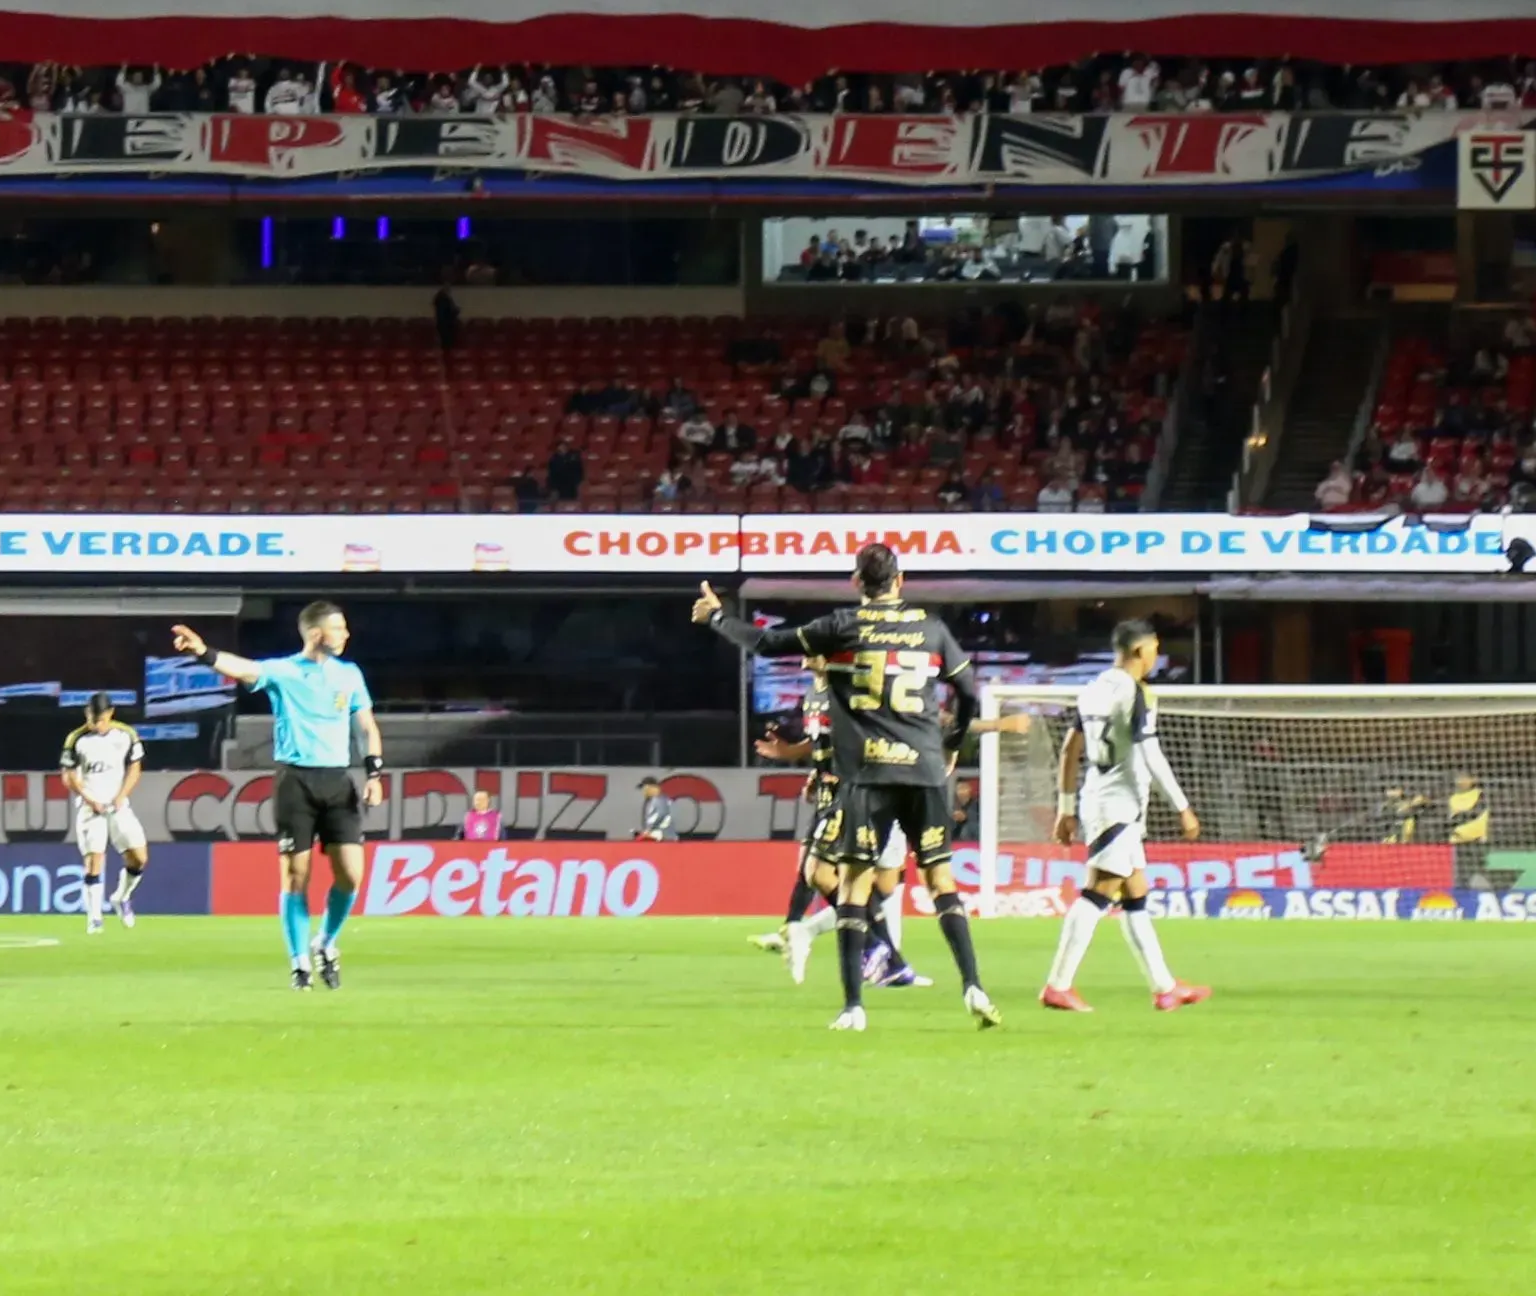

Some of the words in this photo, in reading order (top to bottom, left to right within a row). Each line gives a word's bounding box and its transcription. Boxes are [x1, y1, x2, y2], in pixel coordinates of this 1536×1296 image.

[43, 530, 296, 556] VERDADE.
[564, 530, 738, 556] CHOPP
[742, 530, 976, 555] BRAHMA.
[991, 529, 1164, 554] CHOPP
[1181, 530, 1245, 554] DE
[848, 650, 930, 714] 32
[166, 770, 608, 841] CODUZ
[364, 843, 660, 917] Betano
